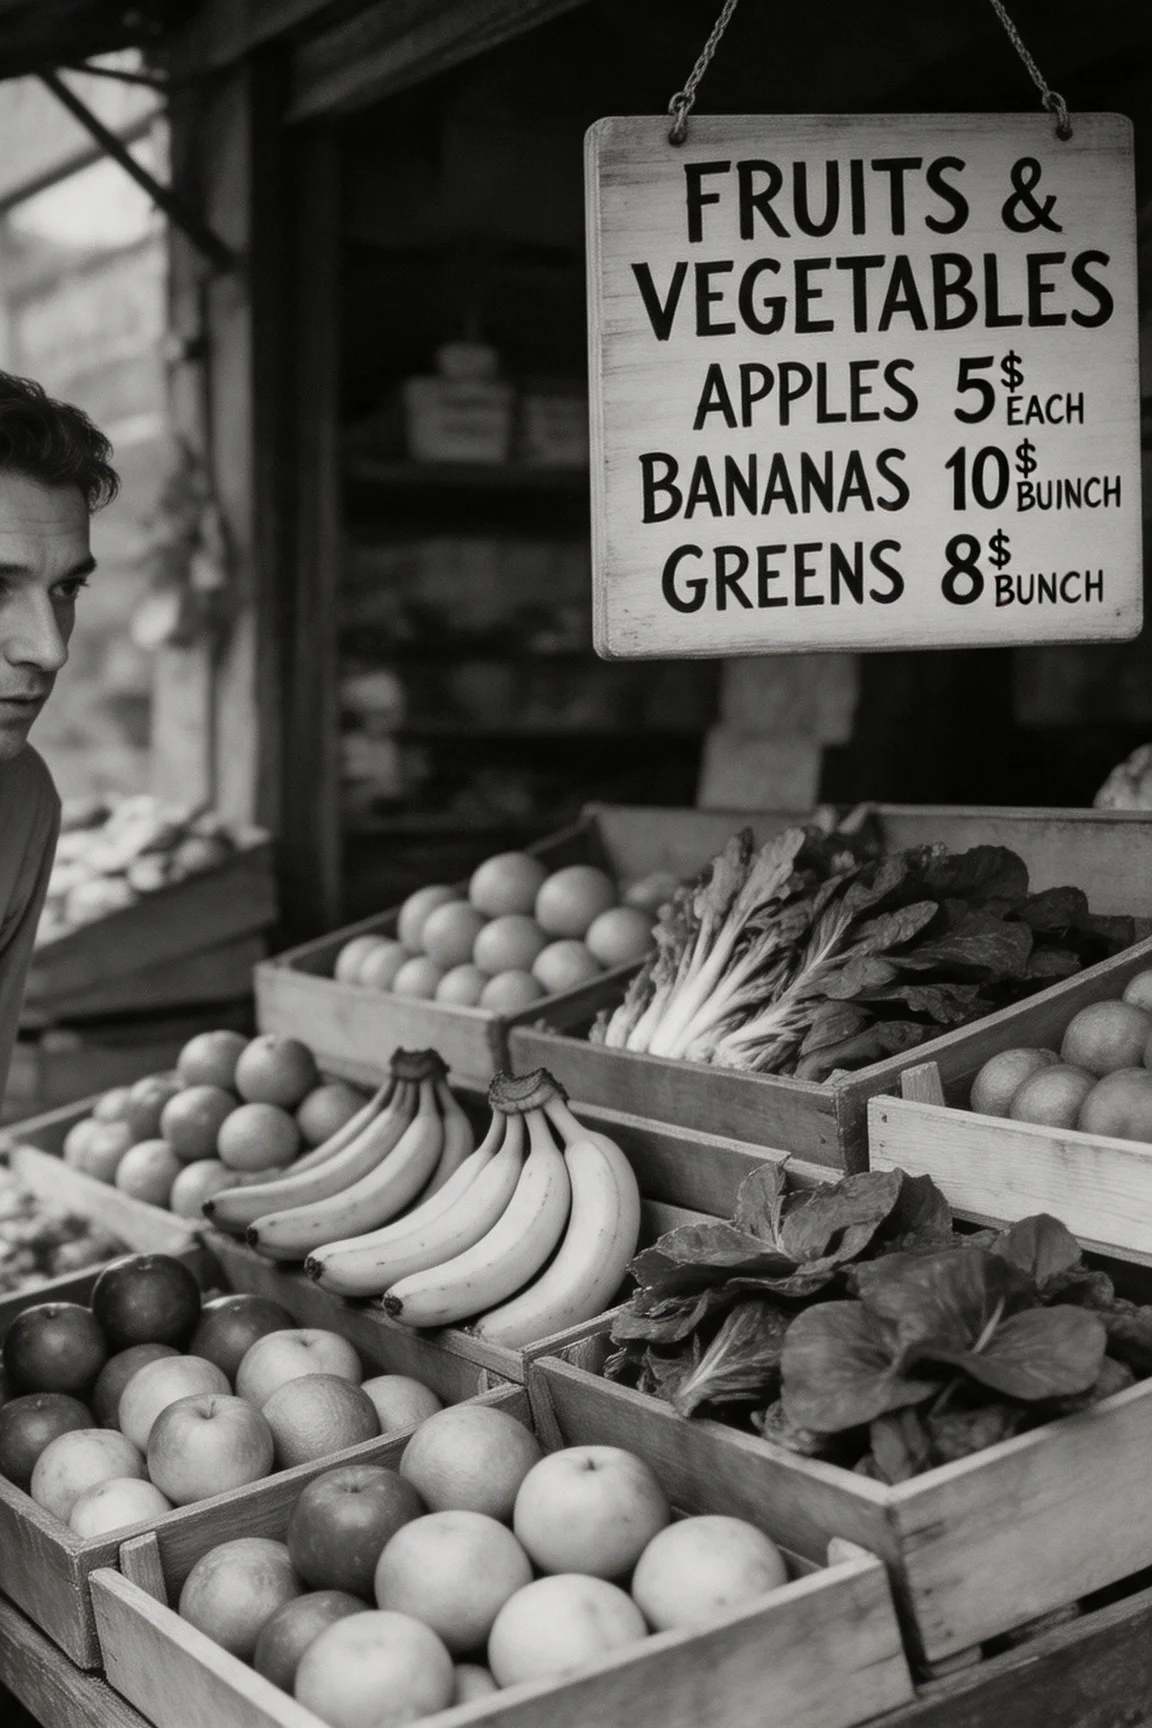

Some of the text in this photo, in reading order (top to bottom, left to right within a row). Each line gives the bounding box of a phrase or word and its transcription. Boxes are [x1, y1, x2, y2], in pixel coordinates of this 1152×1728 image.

[683, 156, 1064, 243] FRUITS &
[631, 250, 1115, 341] VEGETABLES
[693, 359, 919, 430] APPLES
[1006, 391, 1084, 426] EACH
[639, 448, 910, 523] BANANAS
[1016, 475, 1122, 513] BUINCH
[661, 540, 905, 613] GREENS
[994, 569, 1104, 608] BUNCH
